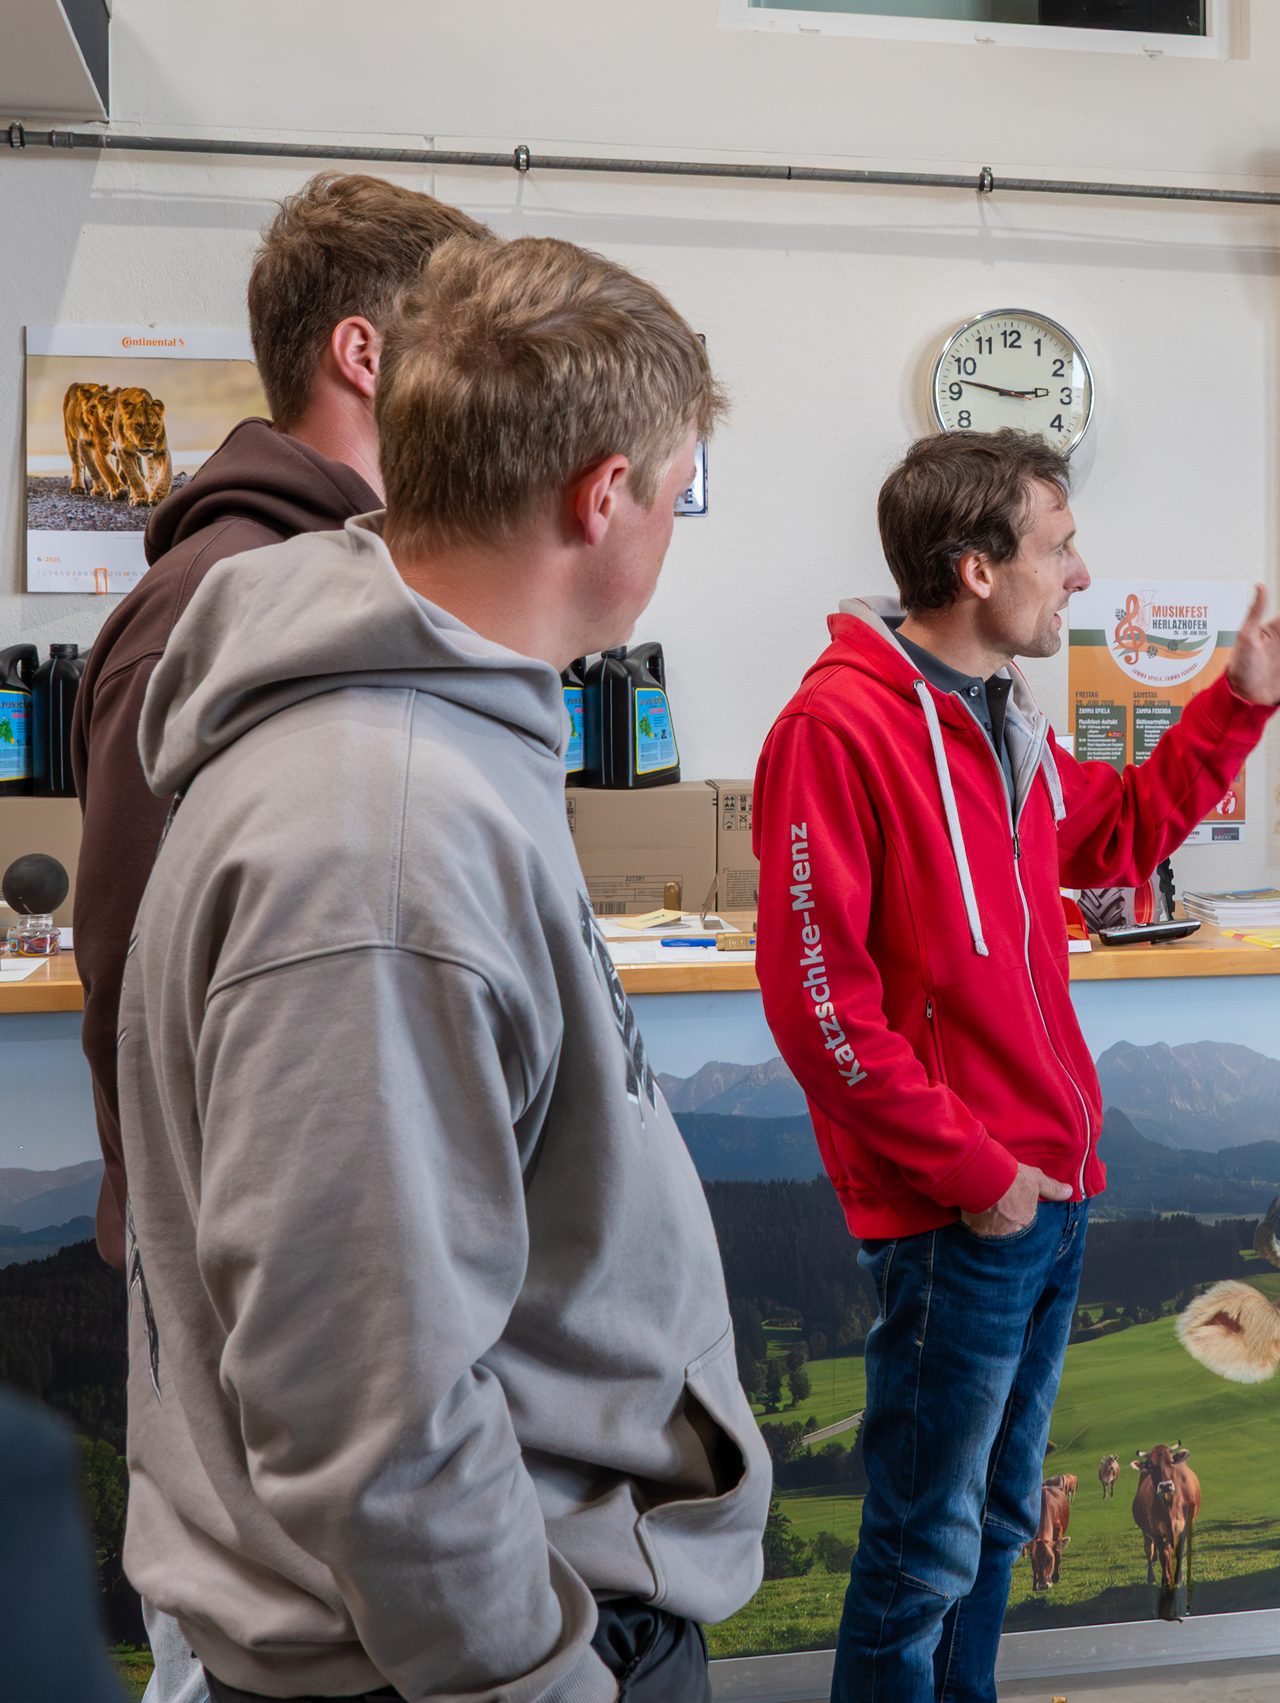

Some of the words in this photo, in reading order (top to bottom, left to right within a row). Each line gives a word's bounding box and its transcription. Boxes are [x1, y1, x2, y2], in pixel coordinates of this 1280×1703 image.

[121, 335, 176, 348] Continental
[976, 336, 993, 355] 11
[1000, 330, 1022, 349] 12
[1034, 338, 1042, 356] 1
[954, 357, 977, 376] 10
[1051, 359, 1065, 377] 2
[949, 382, 963, 401] 9
[1060, 387, 1073, 405] 3
[957, 410, 972, 428] 8
[1050, 414, 1064, 432] 4
[1152, 605, 1208, 618] MUSIKFEST
[1152, 619, 1208, 630] HERLAZHOFEN
[790, 822, 868, 1087] Katzschke-Menz
